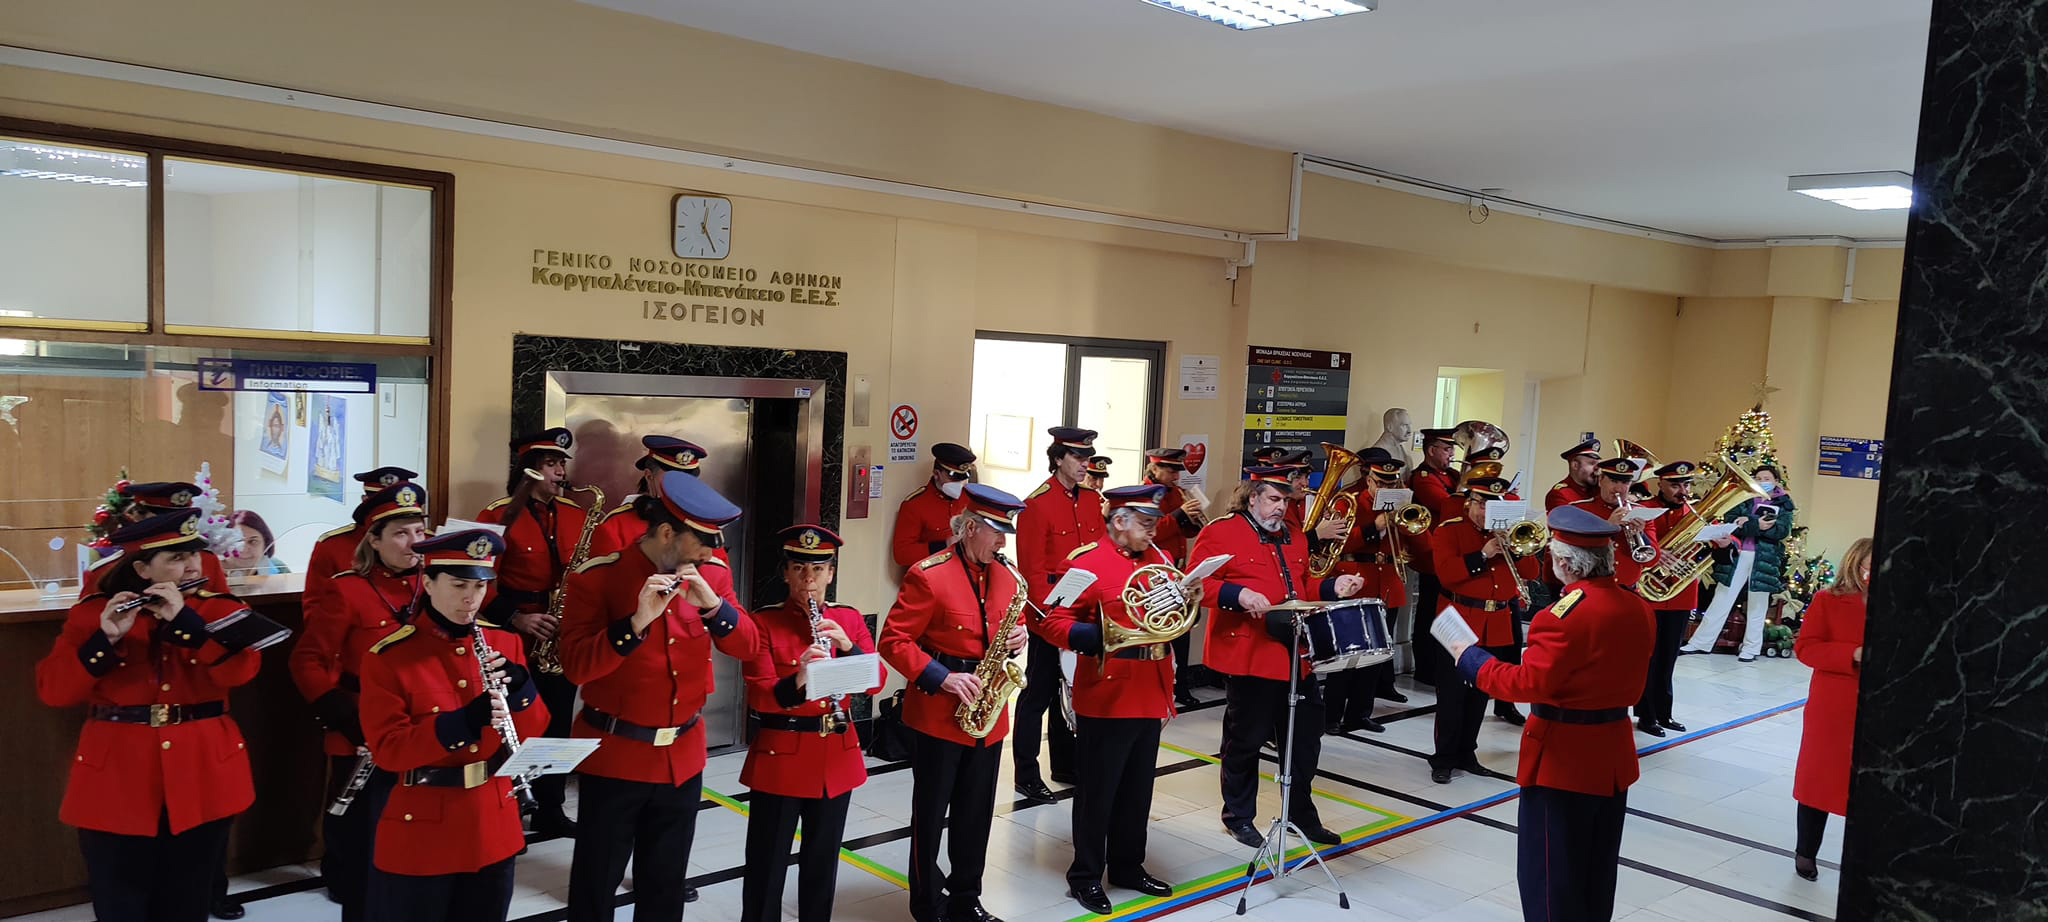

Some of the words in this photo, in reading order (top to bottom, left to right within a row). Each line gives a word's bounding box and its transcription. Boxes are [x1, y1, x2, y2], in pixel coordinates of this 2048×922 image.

[533, 249, 612, 270] ΓΕΝΙΚΟ
[629, 257, 757, 283] ΝΟΣΟΚΟΜΕΙΟ
[770, 271, 842, 290] ΑΘΗΝΩΝ
[532, 267, 785, 303] Κοργιαλένειο-Μπενάκειο
[790, 288, 840, 306] Ε.Ε.Σ.
[643, 301, 765, 327] ΙΣΟΓΕΙΟΝ
[250, 380, 308, 389] Information
